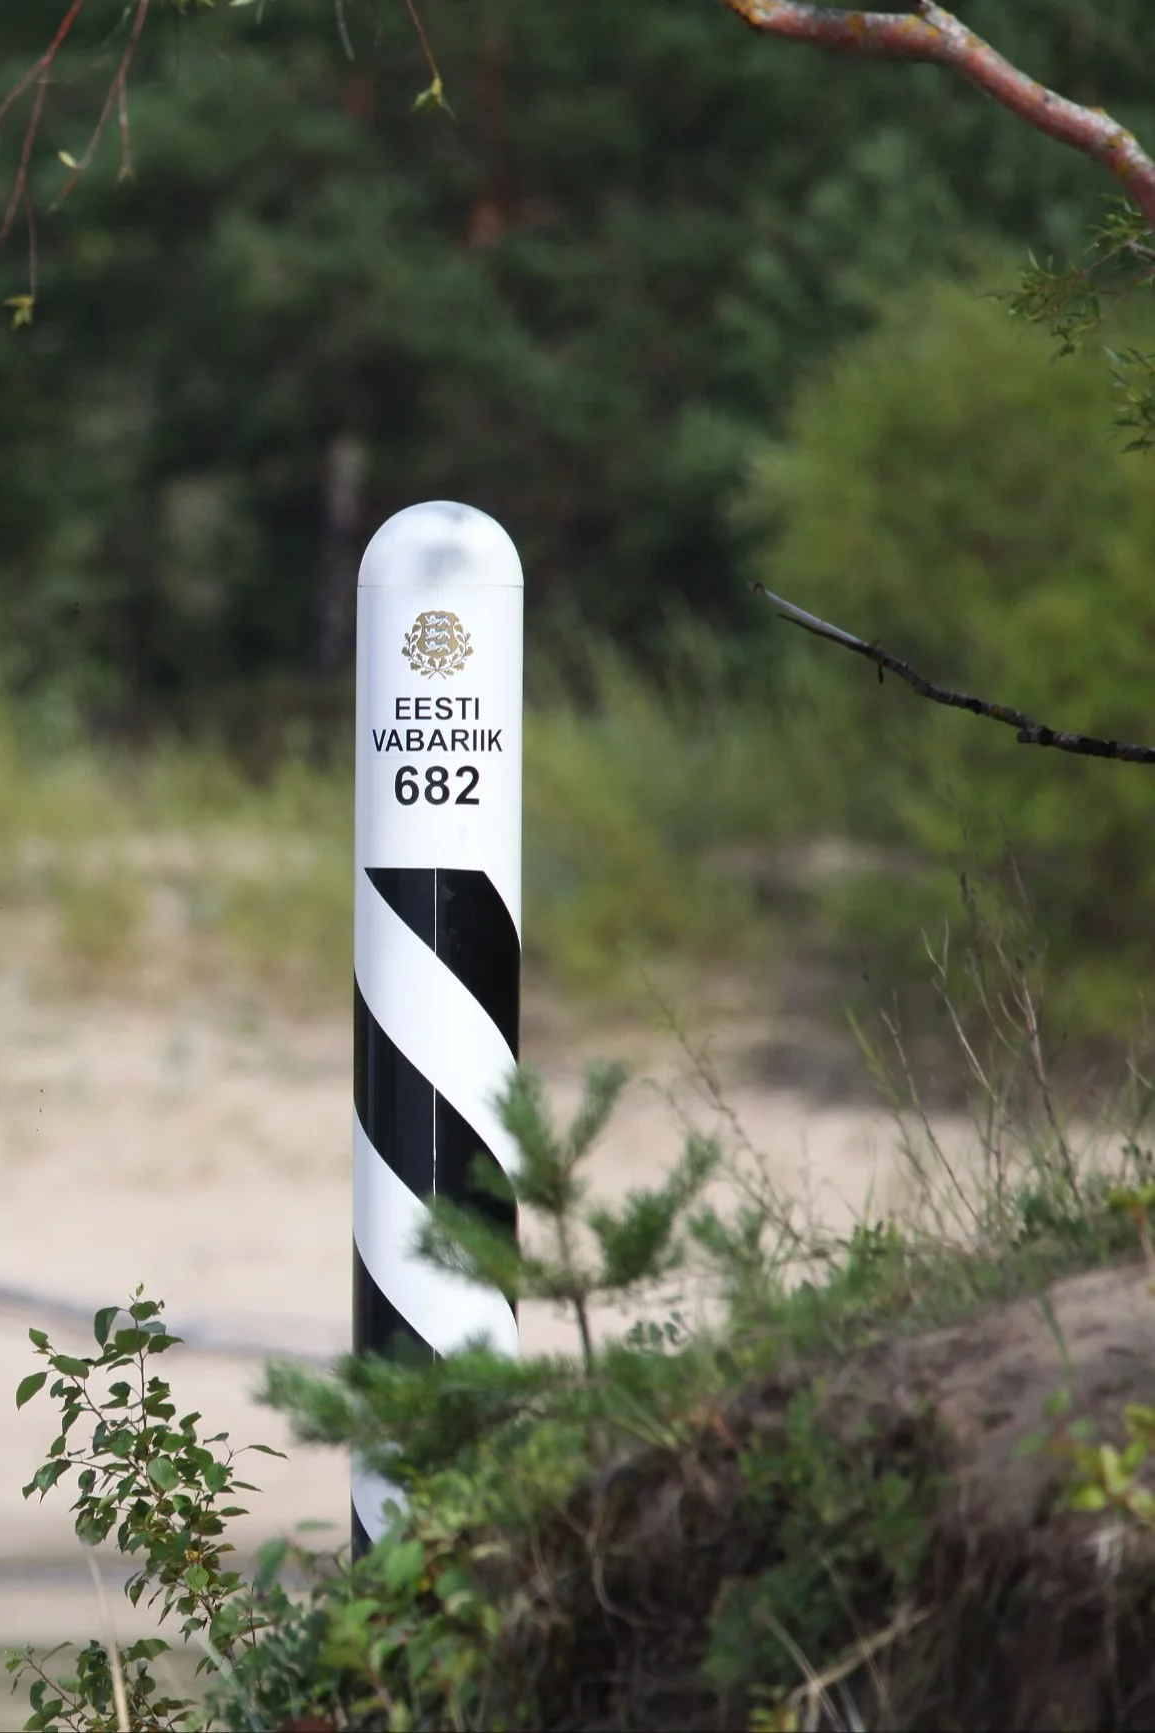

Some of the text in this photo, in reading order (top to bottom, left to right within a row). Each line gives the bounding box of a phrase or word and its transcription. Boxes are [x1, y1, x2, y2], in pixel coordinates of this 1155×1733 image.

[395, 697, 479, 720] EESTI
[372, 729, 503, 752] VABARIIK
[394, 765, 480, 806] 682
